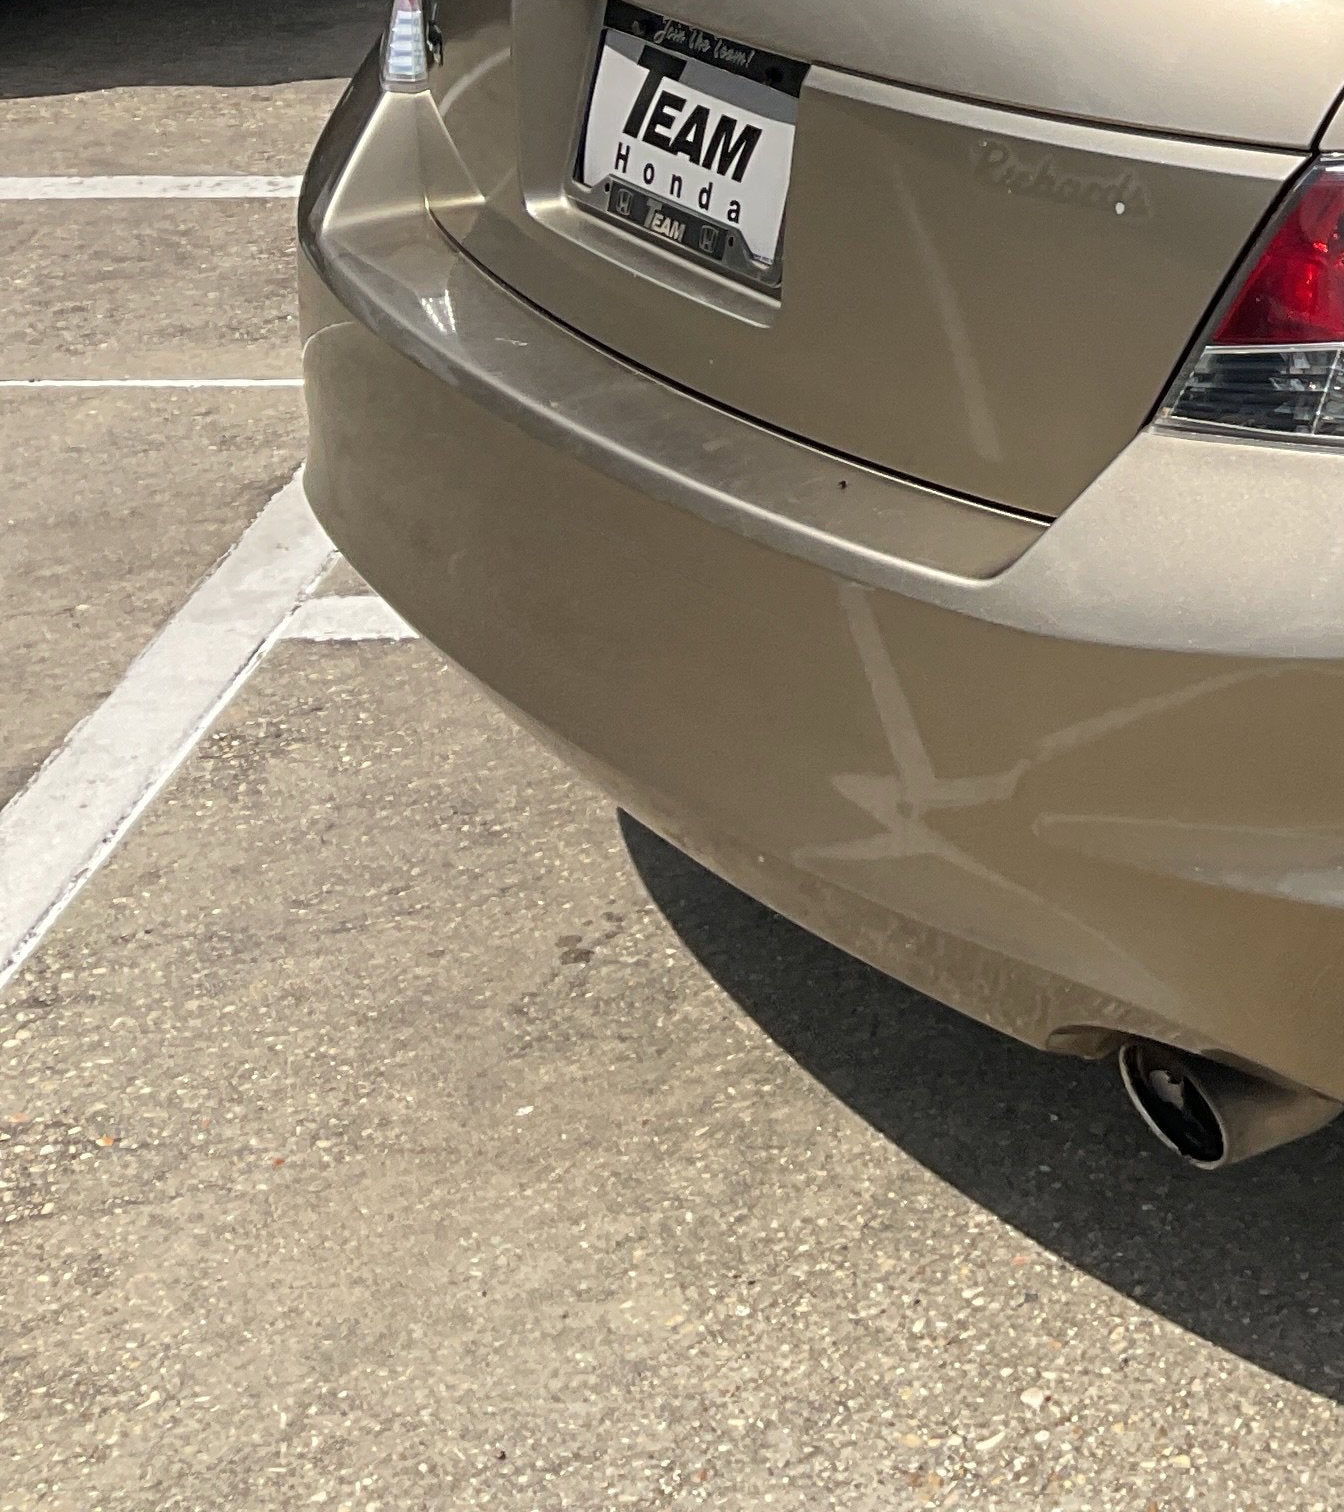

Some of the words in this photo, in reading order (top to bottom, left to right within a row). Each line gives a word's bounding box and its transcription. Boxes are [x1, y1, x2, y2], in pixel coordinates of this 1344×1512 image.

[622, 44, 763, 183] TEAM
[614, 141, 742, 224] Honda
[642, 198, 686, 243] TEAM
